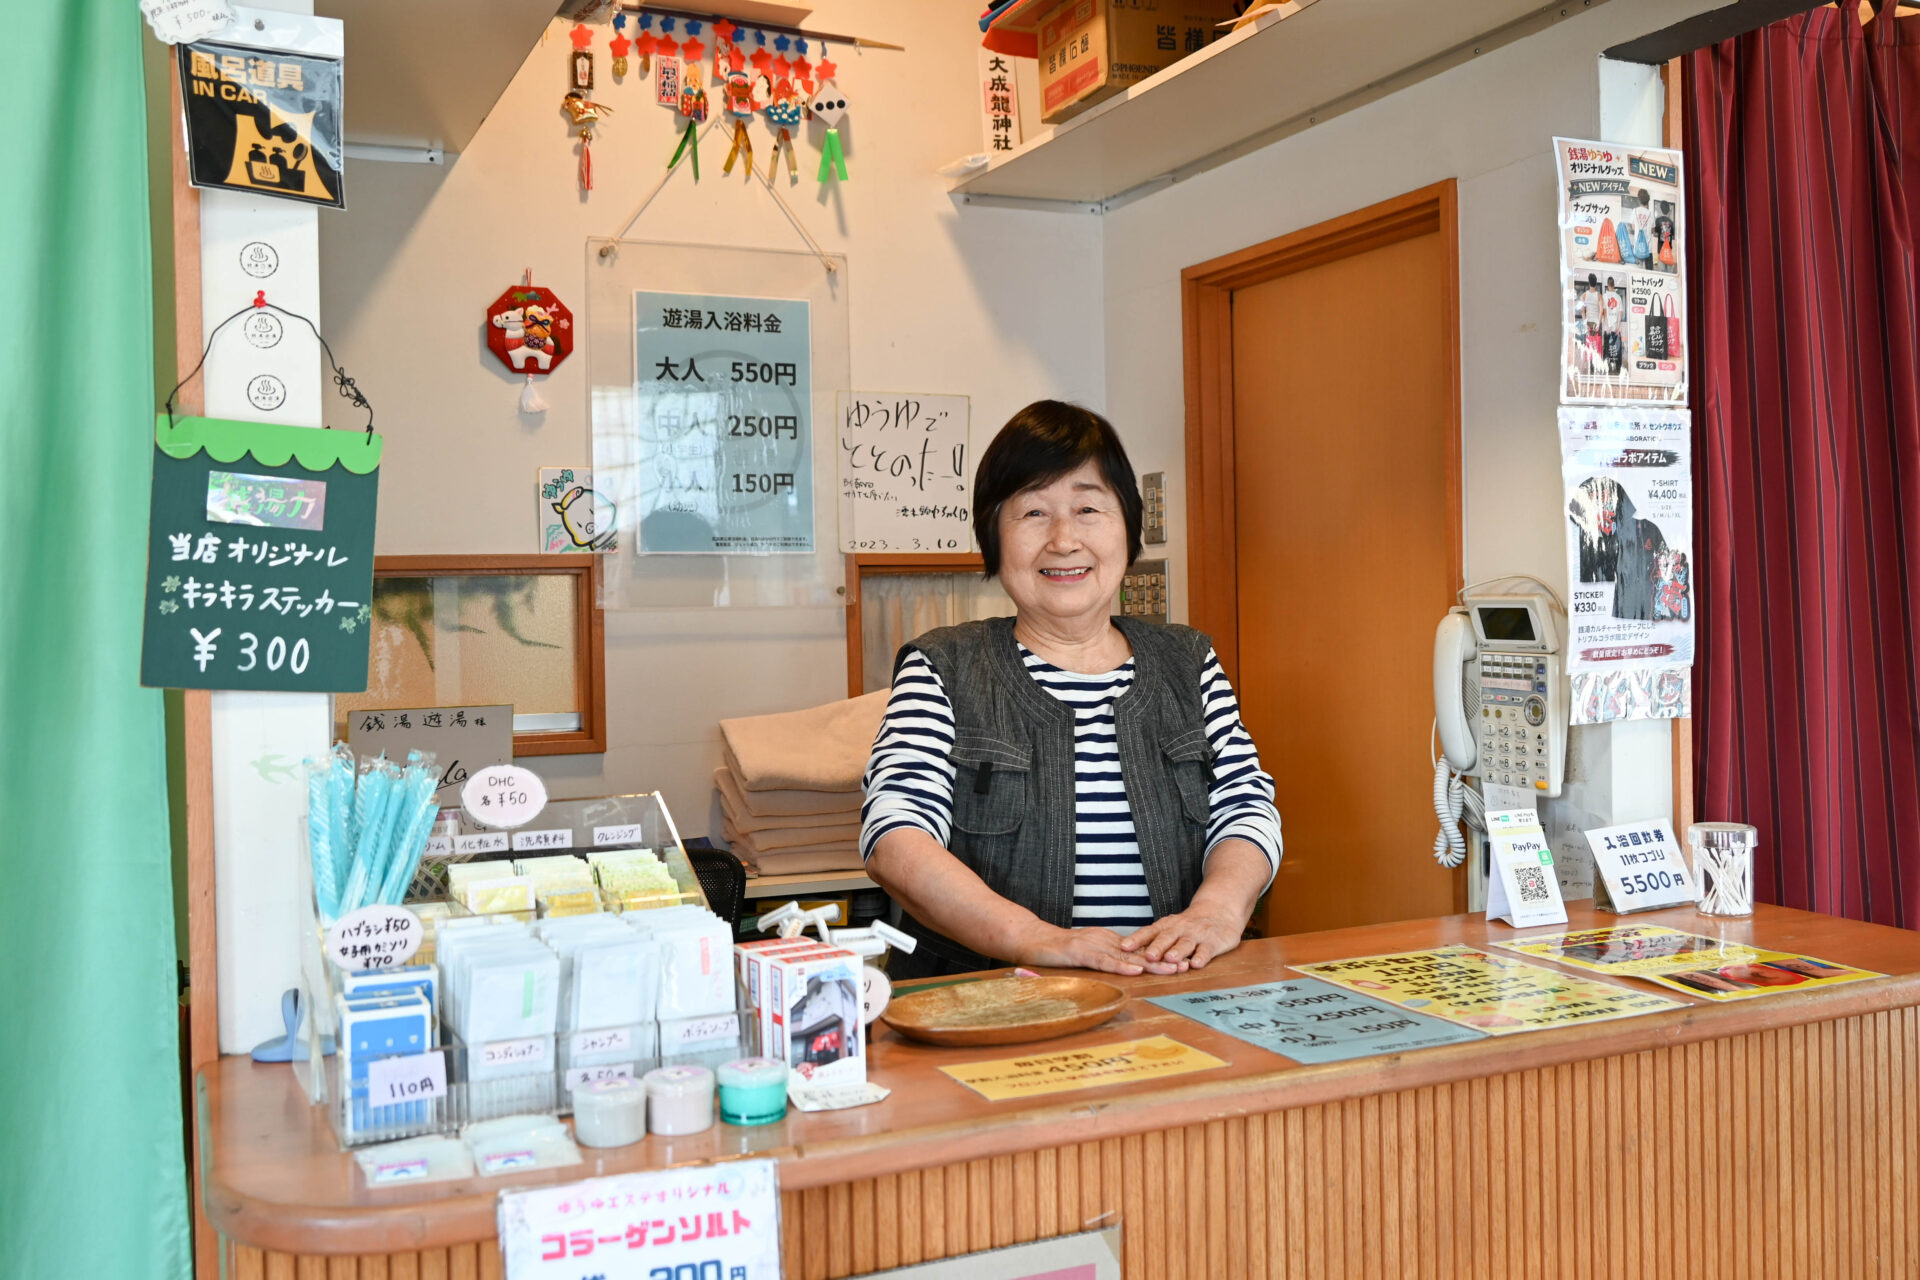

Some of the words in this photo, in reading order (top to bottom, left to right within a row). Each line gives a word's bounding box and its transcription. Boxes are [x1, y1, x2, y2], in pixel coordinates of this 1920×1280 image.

[191, 51, 304, 92] 風呂道具
[193, 80, 215, 97] IN
[221, 84, 268, 107] CAR
[988, 55, 1014, 151] 大成龍神社
[1568, 147, 1612, 162] 銭湯ゆうゆ
[1570, 162, 1624, 176] オリジナルグッズ
[1639, 162, 1668, 178] NEW
[1578, 182, 1601, 192] NEW
[1574, 202, 1610, 214] ナップサック
[1632, 276, 1664, 287] トートバッグ
[662, 308, 782, 334] 遊湯入浴料金
[655, 356, 705, 382] 大人
[730, 362, 797, 386] 550円
[658, 410, 709, 437] 中人
[728, 415, 798, 440] 250円
[732, 473, 795, 496] 150円
[1648, 490, 1677, 500] ¥4,400
[1574, 591, 1604, 600] STICKER
[1574, 602, 1597, 613] ¥330
[488, 776, 515, 787] DHC
[597, 828, 639, 841] クレンジング
[1604, 829, 1664, 850] 入浴回数券
[1512, 842, 1541, 852] PayPay
[363, 955, 393, 969] ¥70
[1374, 961, 1465, 977] 150円
[1276, 992, 1349, 1009] 550円
[1306, 1005, 1387, 1022] 250円
[1350, 1019, 1421, 1034] 150円
[1048, 1055, 1134, 1074] 450円
[390, 1076, 435, 1098] 110円
[541, 1210, 752, 1261] コラーゲンソルト
